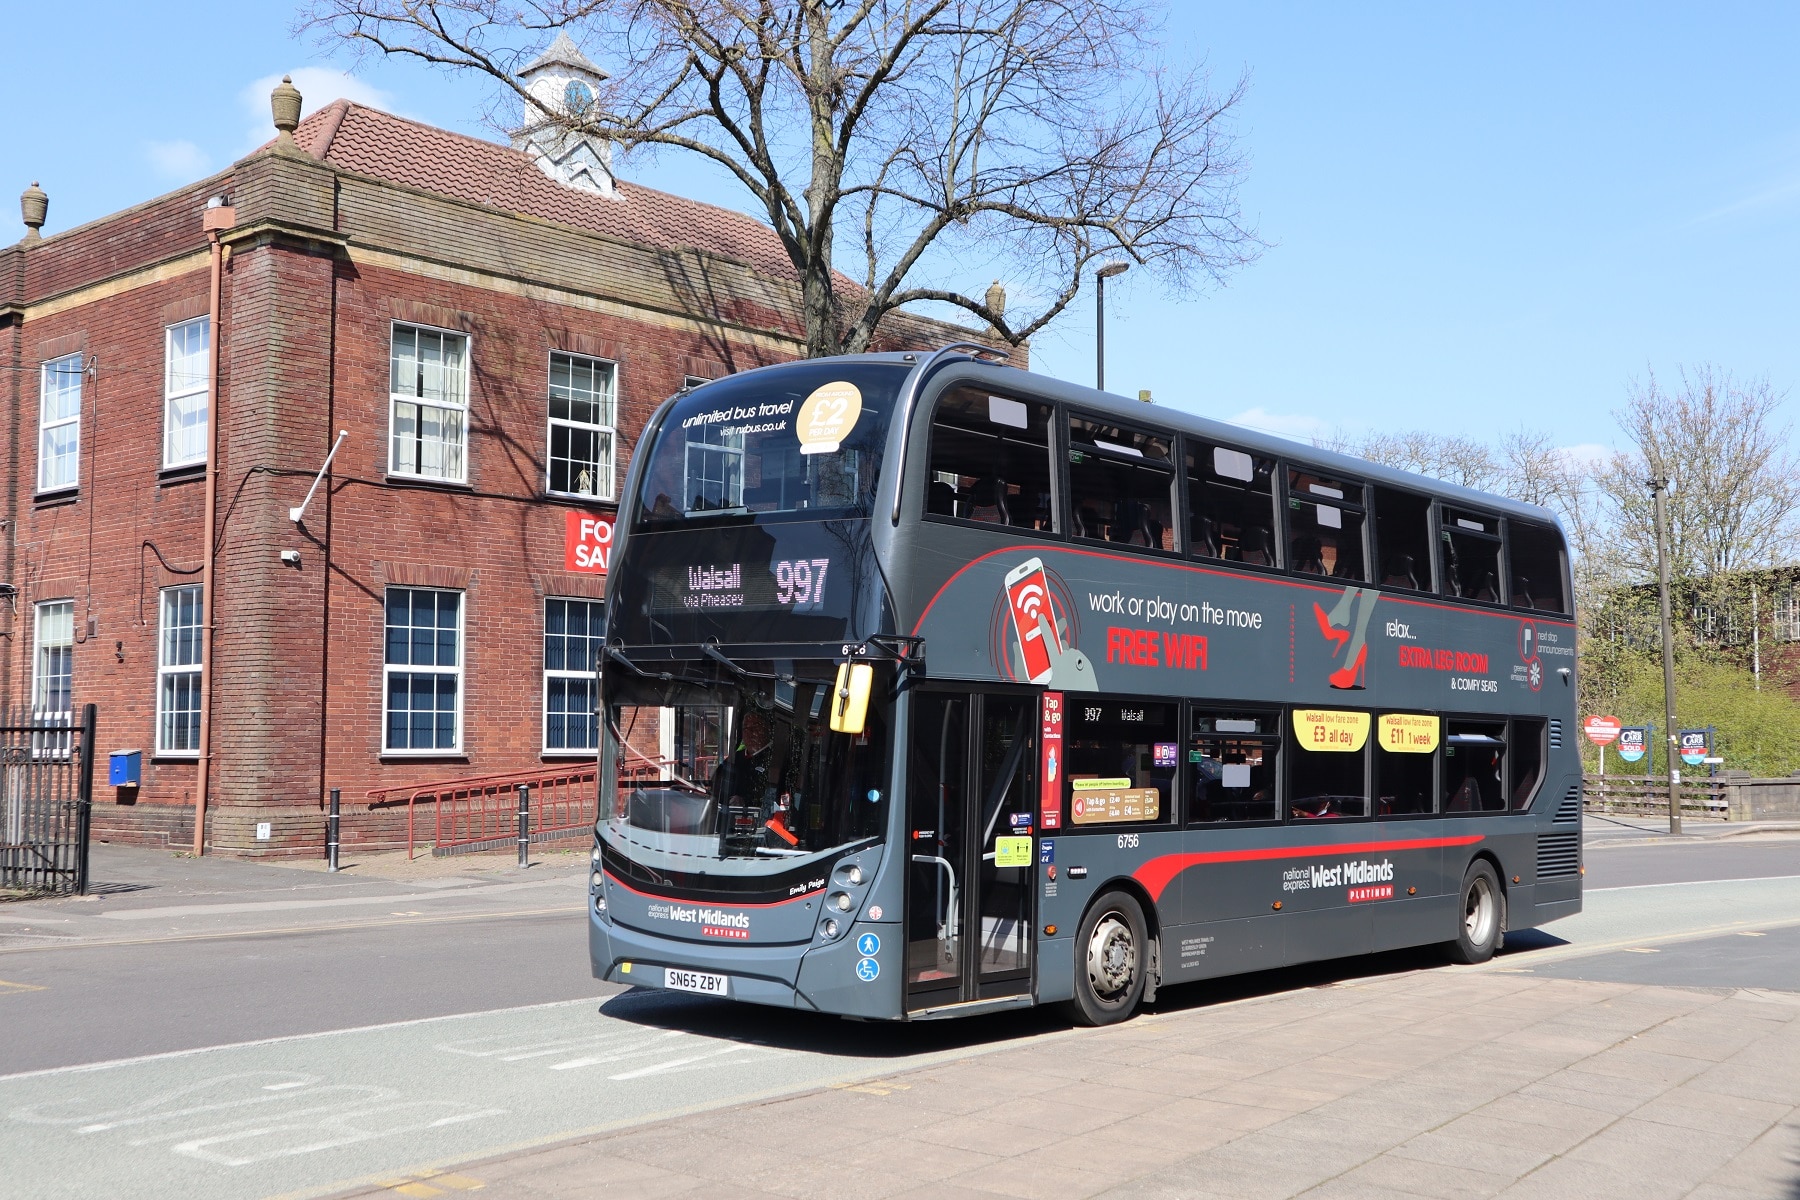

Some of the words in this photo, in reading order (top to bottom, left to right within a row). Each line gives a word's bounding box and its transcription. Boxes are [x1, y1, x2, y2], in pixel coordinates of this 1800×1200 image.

[682, 407, 733, 429] unlimited
[733, 405, 757, 420] bus
[759, 399, 794, 416] travel
[808, 397, 848, 427] £2
[720, 427, 735, 437] visit
[736, 420, 787, 435] nxbus.co.uk
[824, 427, 840, 436] DAY
[580, 518, 615, 544] FO
[689, 563, 741, 590] Walsall
[777, 559, 829, 604] 997
[683, 594, 699, 607] via
[700, 593, 744, 607] Pheasey
[1088, 591, 1125, 614] work
[1128, 597, 1144, 616] or
[1146, 596, 1178, 625] play
[1180, 604, 1199, 622] on
[1202, 602, 1224, 625] the
[1226, 609, 1262, 629] move
[1386, 619, 1417, 640] relax...
[1537, 631, 1547, 640] next
[1548, 632, 1558, 643] stop
[1106, 626, 1159, 667] FREE
[1163, 632, 1208, 671] WIFI
[1537, 644, 1574, 656] announcements
[1399, 645, 1433, 669] EXTRA
[1434, 649, 1454, 671] LEG
[1456, 651, 1489, 674] ROOM
[1513, 665, 1528, 673] greener
[1451, 678, 1456, 690] &
[1457, 678, 1480, 691] COMFY
[1481, 680, 1498, 692] SEATS
[1044, 697, 1058, 710] Tap
[1044, 710, 1051, 721] &
[1051, 713, 1061, 724] go
[1084, 707, 1102, 721] 997
[1121, 709, 1144, 721] Walsall
[1306, 713, 1325, 723] Walsall
[1325, 715, 1335, 723] low
[1336, 714, 1346, 724] fare
[1386, 717, 1402, 725] Walsall
[1402, 718, 1412, 726] low
[1412, 718, 1421, 726] fare
[1314, 726, 1326, 743] £3
[1329, 729, 1338, 742] all
[1340, 729, 1353, 746] day
[1391, 728, 1404, 744] £11
[1408, 732, 1412, 744] 1
[1413, 732, 1431, 745] week
[1621, 732, 1642, 743] CARR
[1682, 735, 1704, 746] CARR
[1086, 797, 1094, 806] Tap
[1099, 798, 1106, 806] go
[1124, 806, 1132, 816] £4
[1118, 834, 1139, 849] 6756
[1282, 866, 1310, 880] national
[1311, 864, 1342, 888] West
[1343, 859, 1394, 885] Midlands
[789, 884, 807, 896] Emily
[808, 878, 825, 888] Paige
[1282, 880, 1310, 893] express
[1350, 887, 1392, 900] PLATINUM
[648, 904, 669, 913] national
[670, 906, 697, 923] West
[698, 908, 750, 928] Midlands
[648, 912, 669, 920] express
[704, 927, 747, 938] PLATINUM
[670, 972, 697, 987] SN65
[700, 974, 722, 992] ZBY
